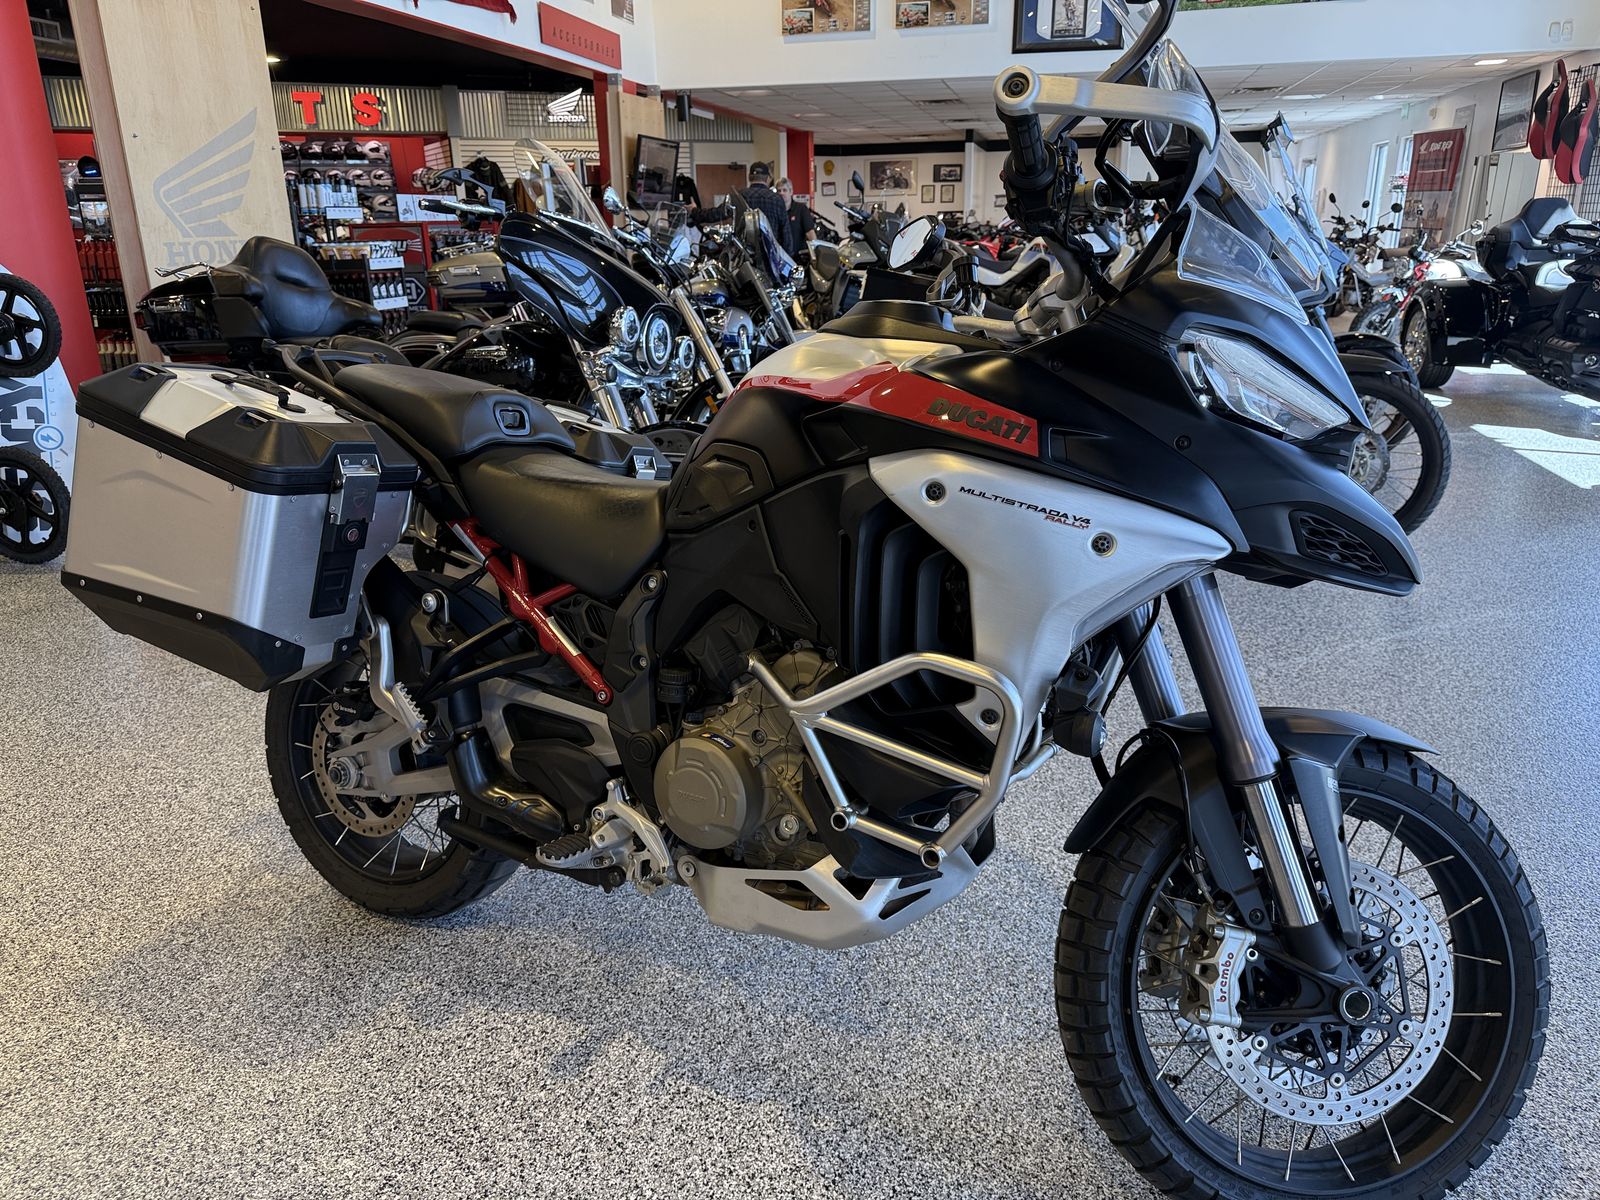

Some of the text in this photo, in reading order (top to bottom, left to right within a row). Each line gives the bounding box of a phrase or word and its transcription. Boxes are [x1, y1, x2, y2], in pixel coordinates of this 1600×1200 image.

[552, 26, 615, 60] ACCESSORIES
[547, 114, 588, 123] HONDA
[163, 240, 246, 268] HON
[48, 375, 57, 417] CYCL
[926, 398, 1033, 445] DUCATI
[958, 486, 1092, 525] MULTISTRADA V4
[1044, 514, 1090, 530] RALLY
[1215, 952, 1234, 1003] brembo
